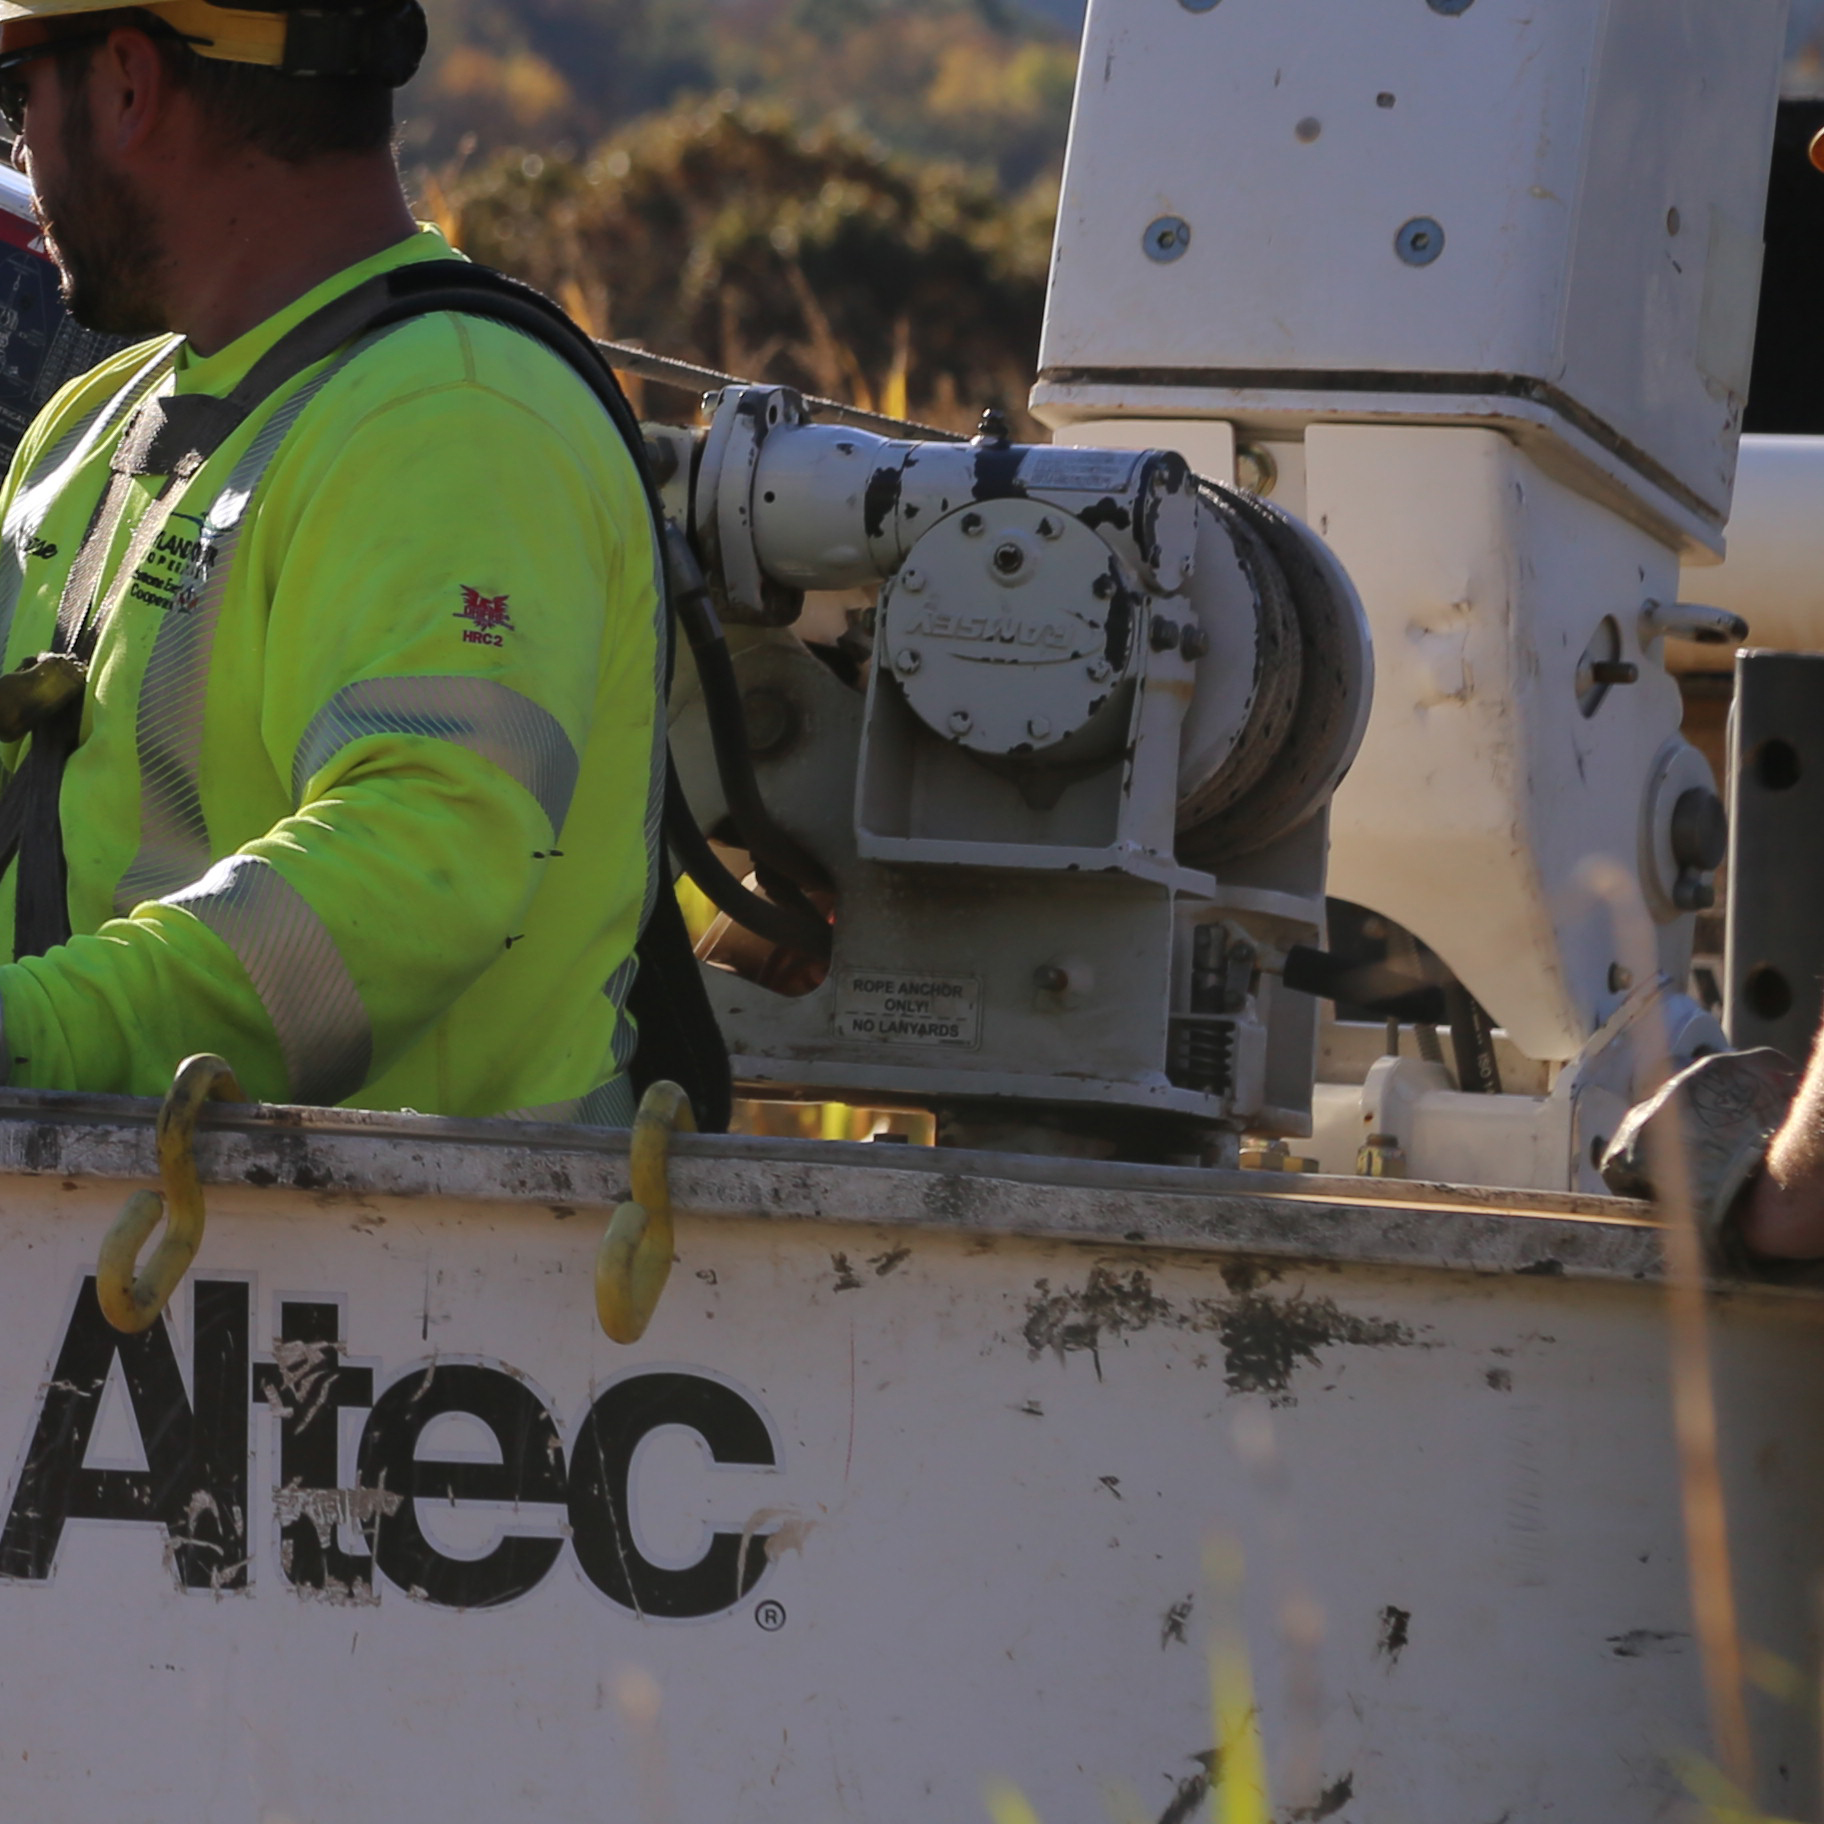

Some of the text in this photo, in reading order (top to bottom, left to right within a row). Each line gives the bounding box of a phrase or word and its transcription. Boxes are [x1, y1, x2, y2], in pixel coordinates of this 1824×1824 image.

[904, 614, 1071, 650] RAMSEY
[853, 979, 964, 998] ROPE ANCHOR
[884, 998, 930, 1013] ONLY!
[853, 1018, 960, 1038] NO LANYARDS
